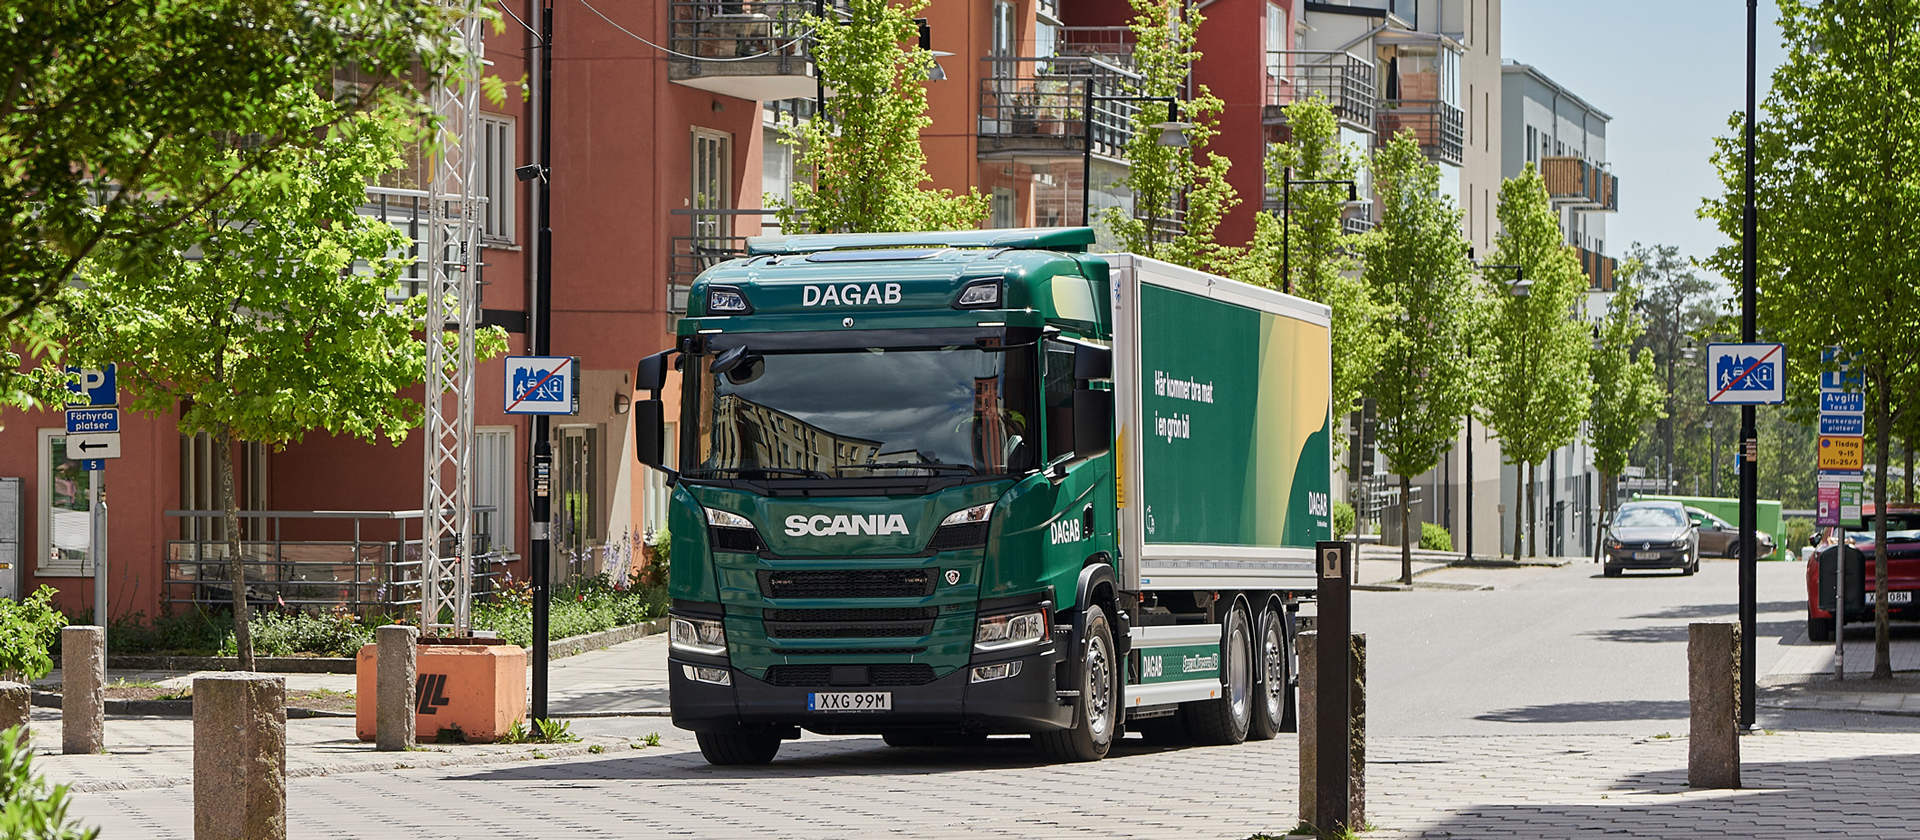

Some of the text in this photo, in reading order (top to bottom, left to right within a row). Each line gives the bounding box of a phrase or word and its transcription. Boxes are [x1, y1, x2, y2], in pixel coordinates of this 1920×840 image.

[802, 283, 902, 306] DAGAB
[81, 368, 105, 395] P
[1154, 370, 1213, 404] Här kommer bra mat
[1826, 394, 1859, 404] Avgift
[70, 412, 113, 422] Förhyrda
[75, 422, 109, 432] platser
[1158, 417, 1167, 437] en
[1167, 412, 1182, 444] grön
[1182, 413, 1190, 439] bil
[91, 461, 97, 469] 5
[1308, 491, 1328, 517] DAGAB
[784, 514, 910, 537] SCANIA
[1050, 518, 1081, 545] DAGAB
[1889, 592, 1908, 601] 08N
[1143, 655, 1163, 678] DAGAB
[820, 694, 885, 708] XXG 99M
